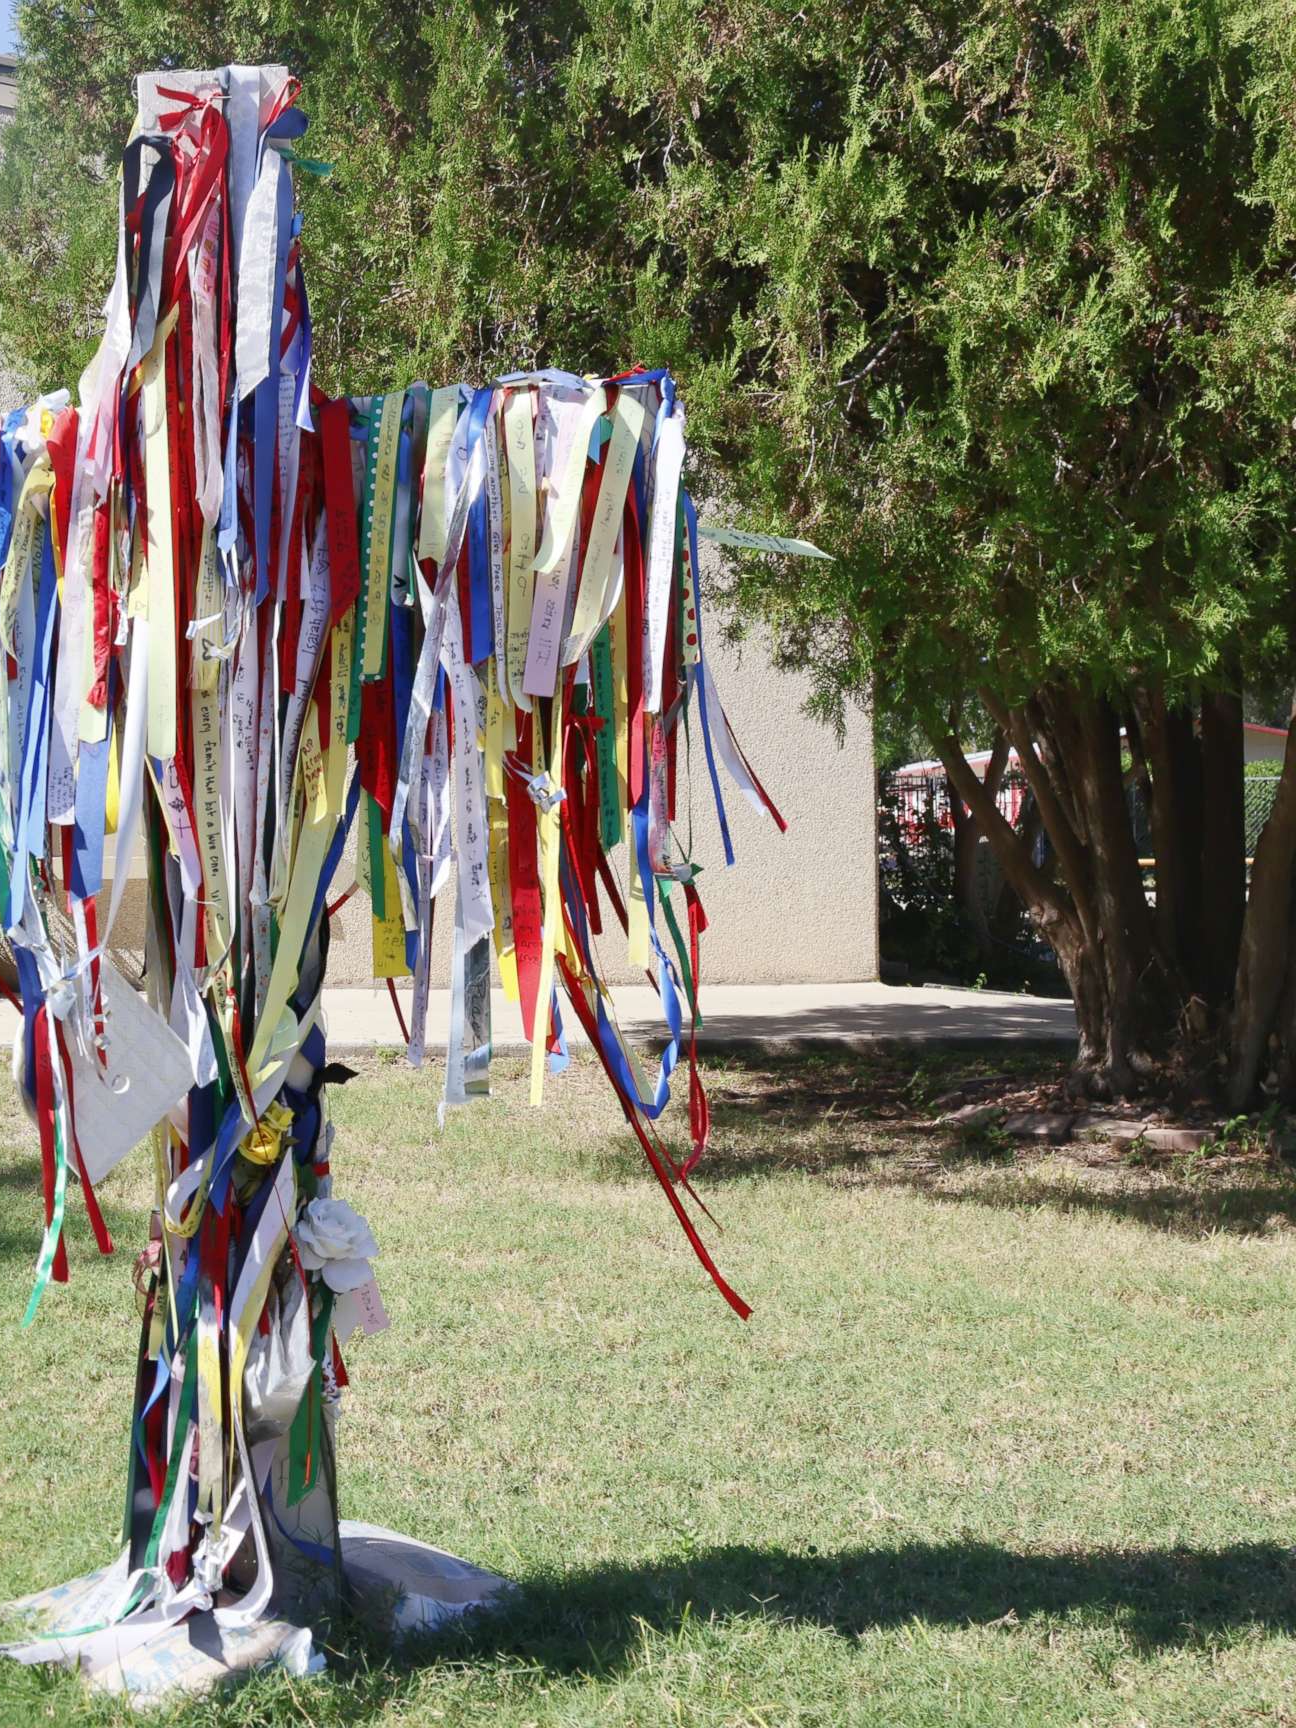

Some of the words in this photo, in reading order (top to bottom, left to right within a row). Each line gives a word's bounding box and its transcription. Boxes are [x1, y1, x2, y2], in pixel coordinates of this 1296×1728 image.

[494, 563, 502, 592] Peace
[495, 606, 504, 635] Jesus
[301, 618, 323, 656] Isaiah
[200, 706, 211, 733] every
[204, 740, 216, 772] family
[205, 776, 215, 795] that
[206, 821, 214, 829] a
[207, 833, 220, 850] love
